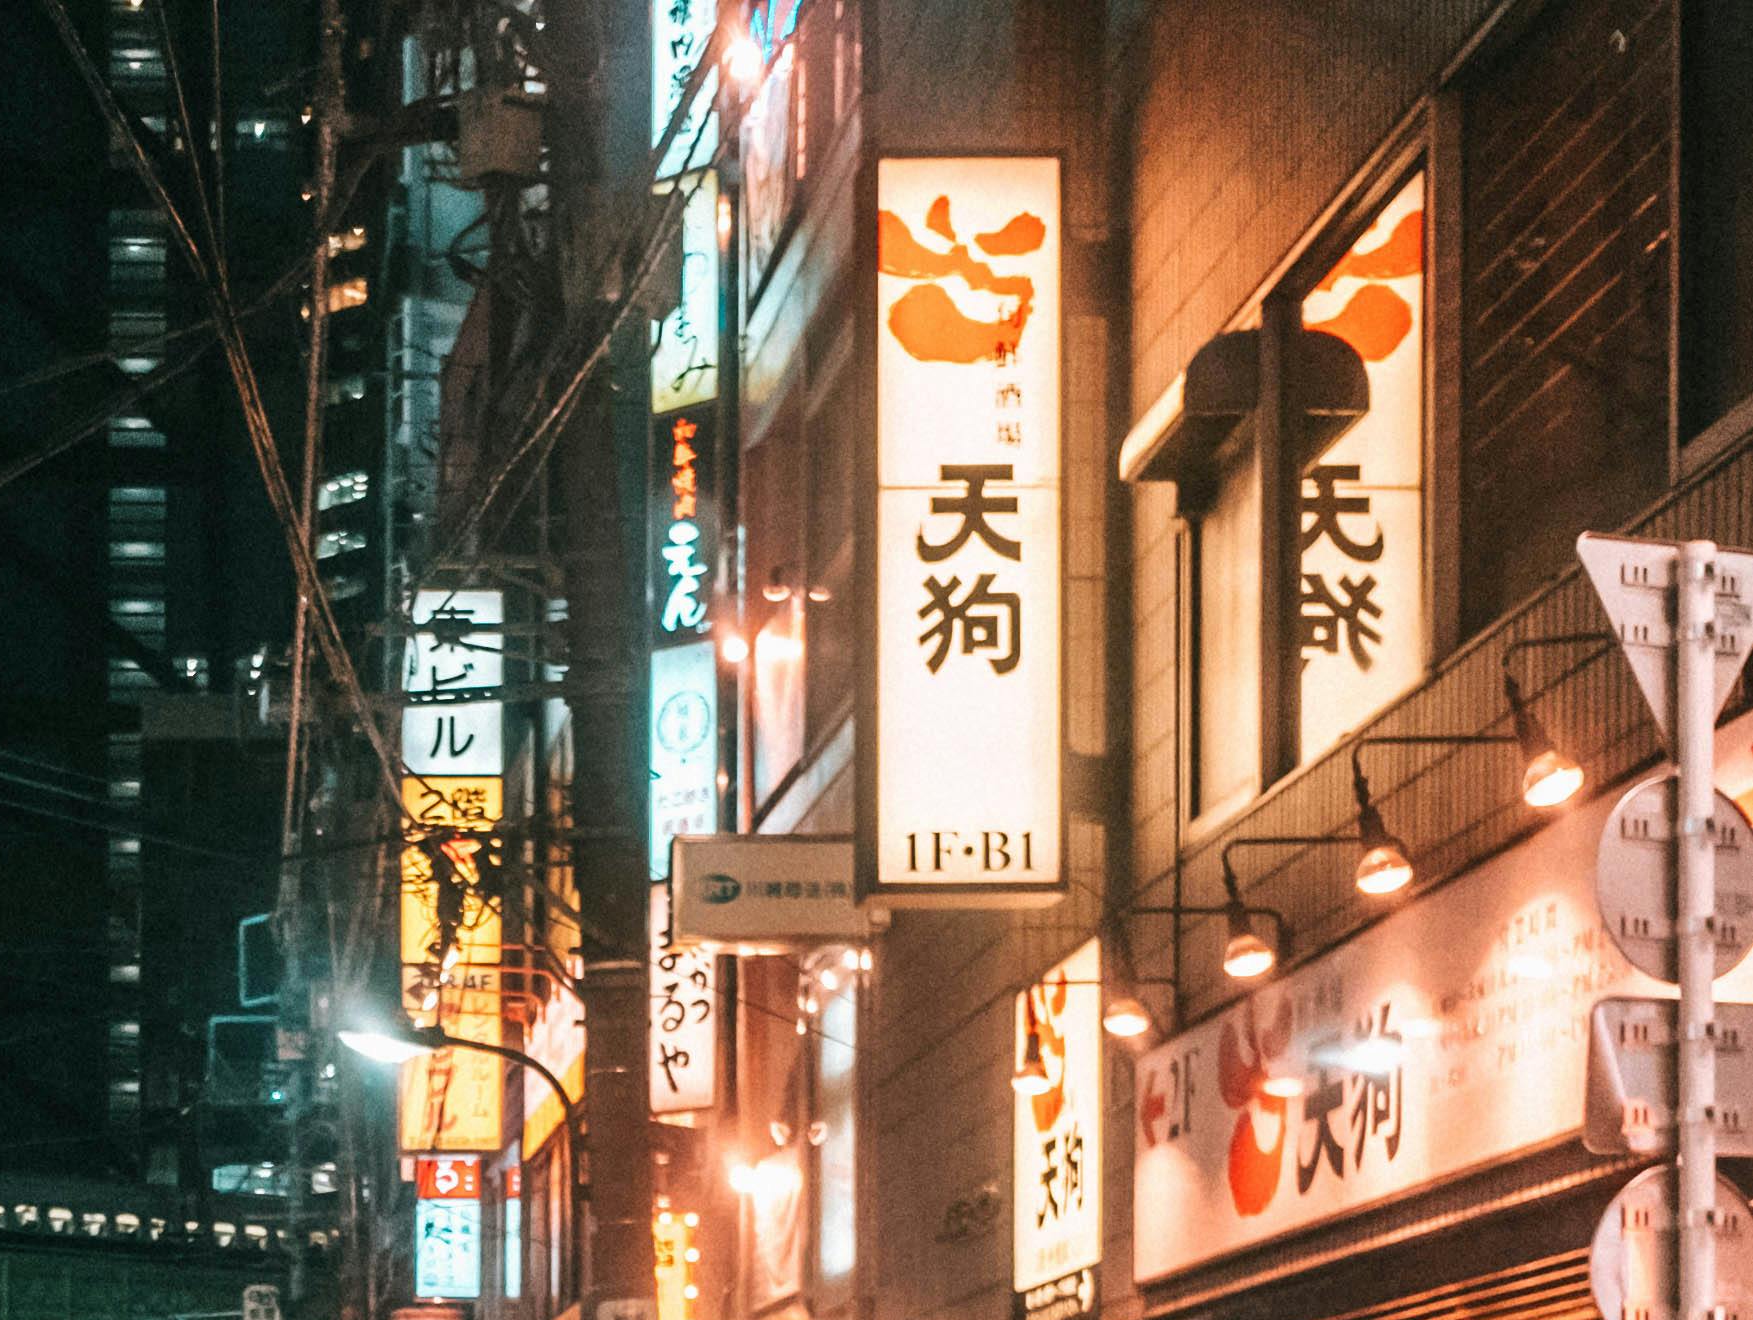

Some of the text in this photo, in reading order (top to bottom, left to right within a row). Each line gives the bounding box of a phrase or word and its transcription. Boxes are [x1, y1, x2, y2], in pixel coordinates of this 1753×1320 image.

[917, 464, 1023, 678] 天狗
[428, 605, 477, 758] ビル
[1036, 1121, 1085, 1231] 天狗
